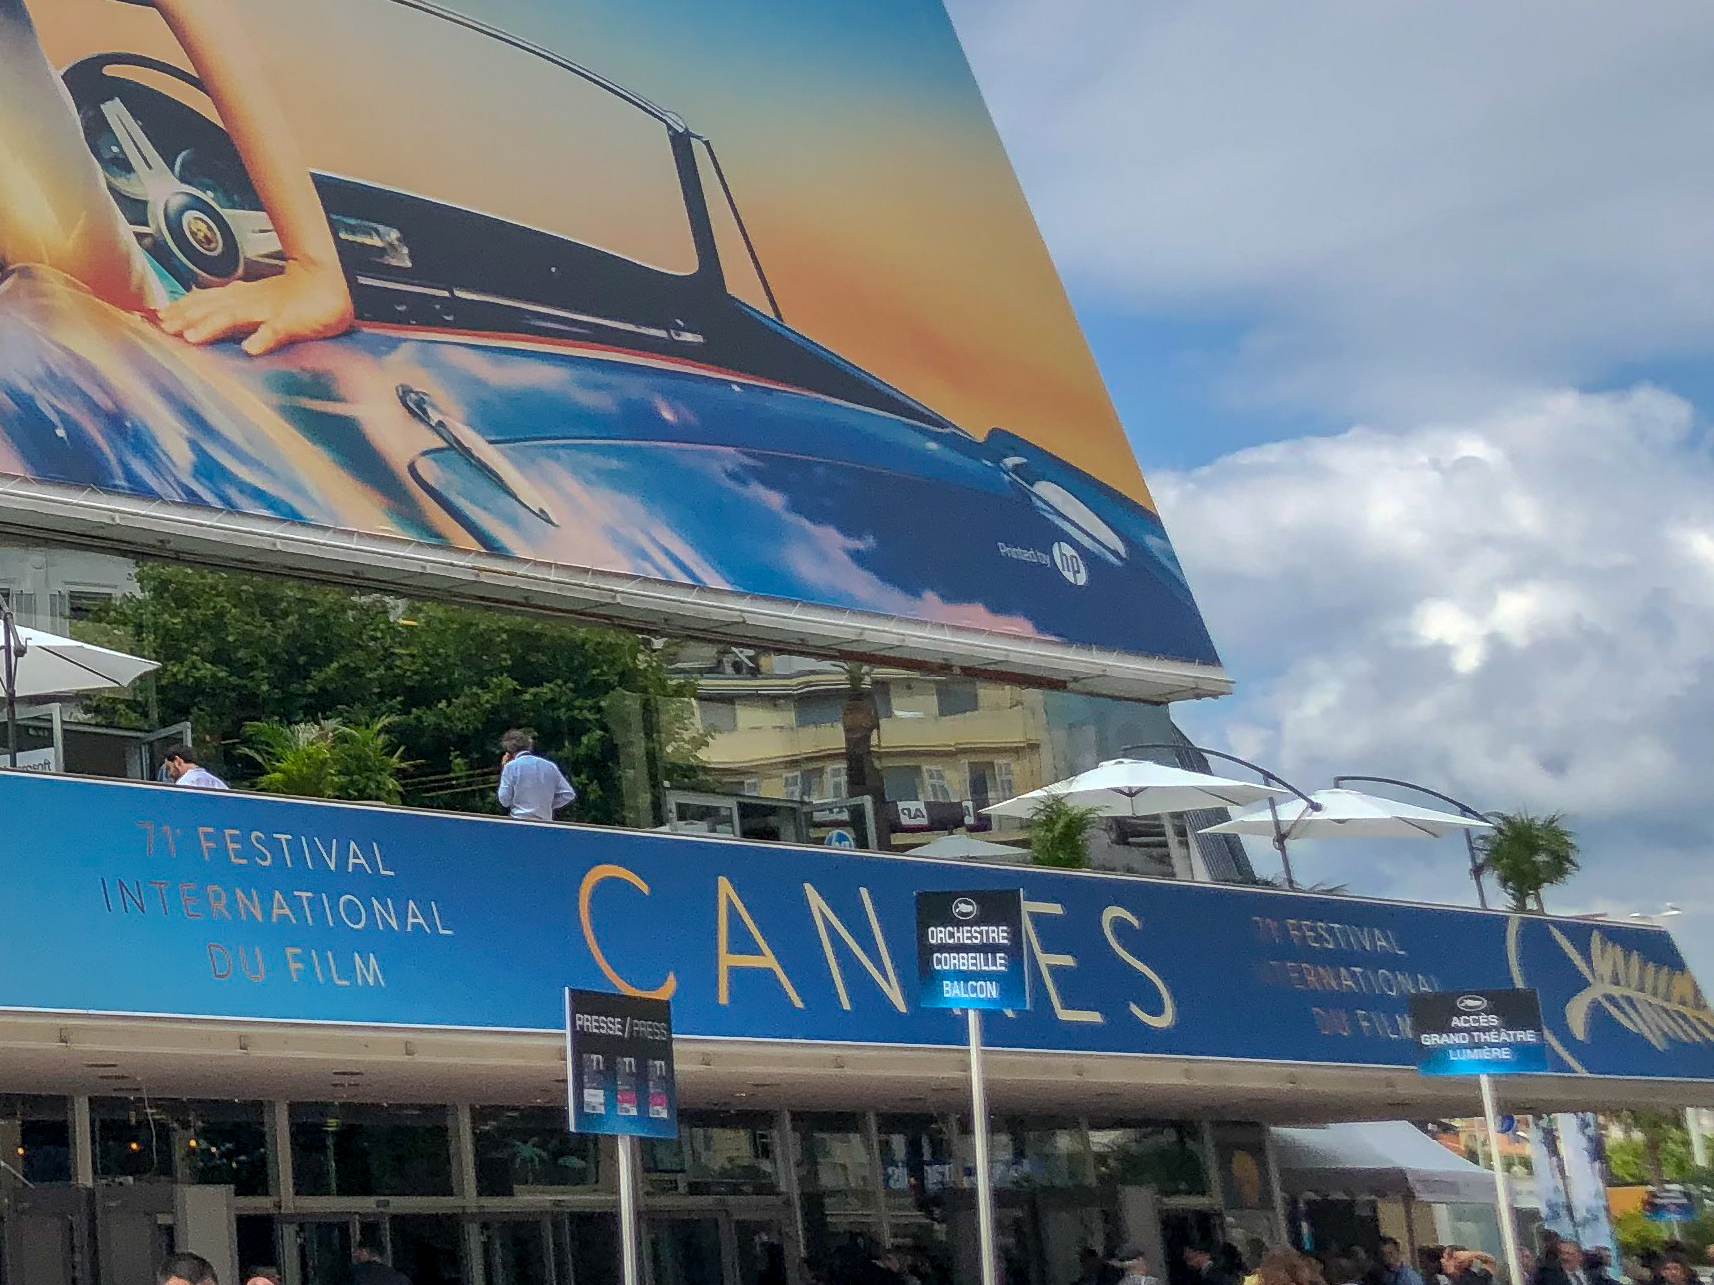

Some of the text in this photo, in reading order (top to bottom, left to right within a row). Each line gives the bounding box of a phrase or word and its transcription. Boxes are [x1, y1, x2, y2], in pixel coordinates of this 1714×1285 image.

[1057, 541, 1081, 586] hp
[198, 825, 395, 877] FESTIVAL
[100, 876, 455, 936] INTERNATIONAL
[927, 925, 1009, 944] ORCHESTRE
[1286, 918, 1407, 956] FESTIVAL
[578, 864, 1176, 1029] CANES
[207, 942, 386, 987] DU FILM
[932, 952, 1008, 971] CORBEILLE
[942, 980, 997, 999] BALCON
[576, 1014, 623, 1035] PRESSE
[1451, 1013, 1498, 1028] ACCÈS
[1420, 1029, 1537, 1045] GRAND THÉÂTRE
[1448, 1046, 1512, 1061] LUMIÈRE
